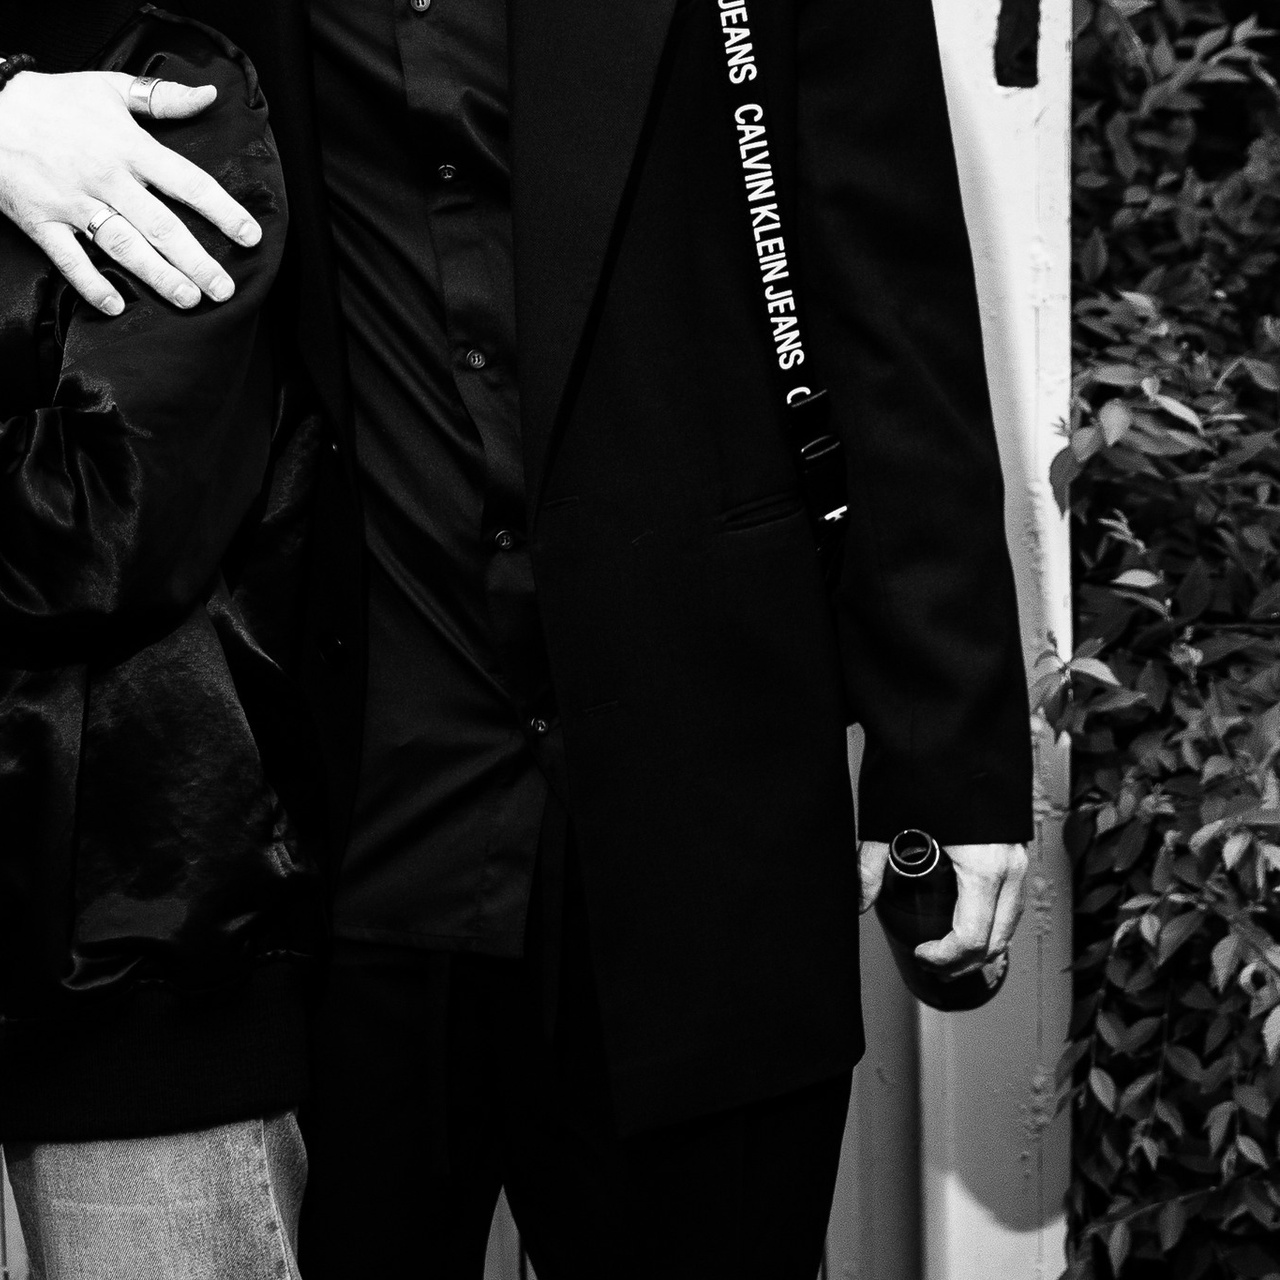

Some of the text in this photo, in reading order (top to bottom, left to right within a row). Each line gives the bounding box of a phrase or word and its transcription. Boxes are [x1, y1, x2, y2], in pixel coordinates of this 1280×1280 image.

[734, 103, 776, 202] CALVIN
[750, 203, 790, 283] KLEIN
[764, 285, 805, 370] JEANS
